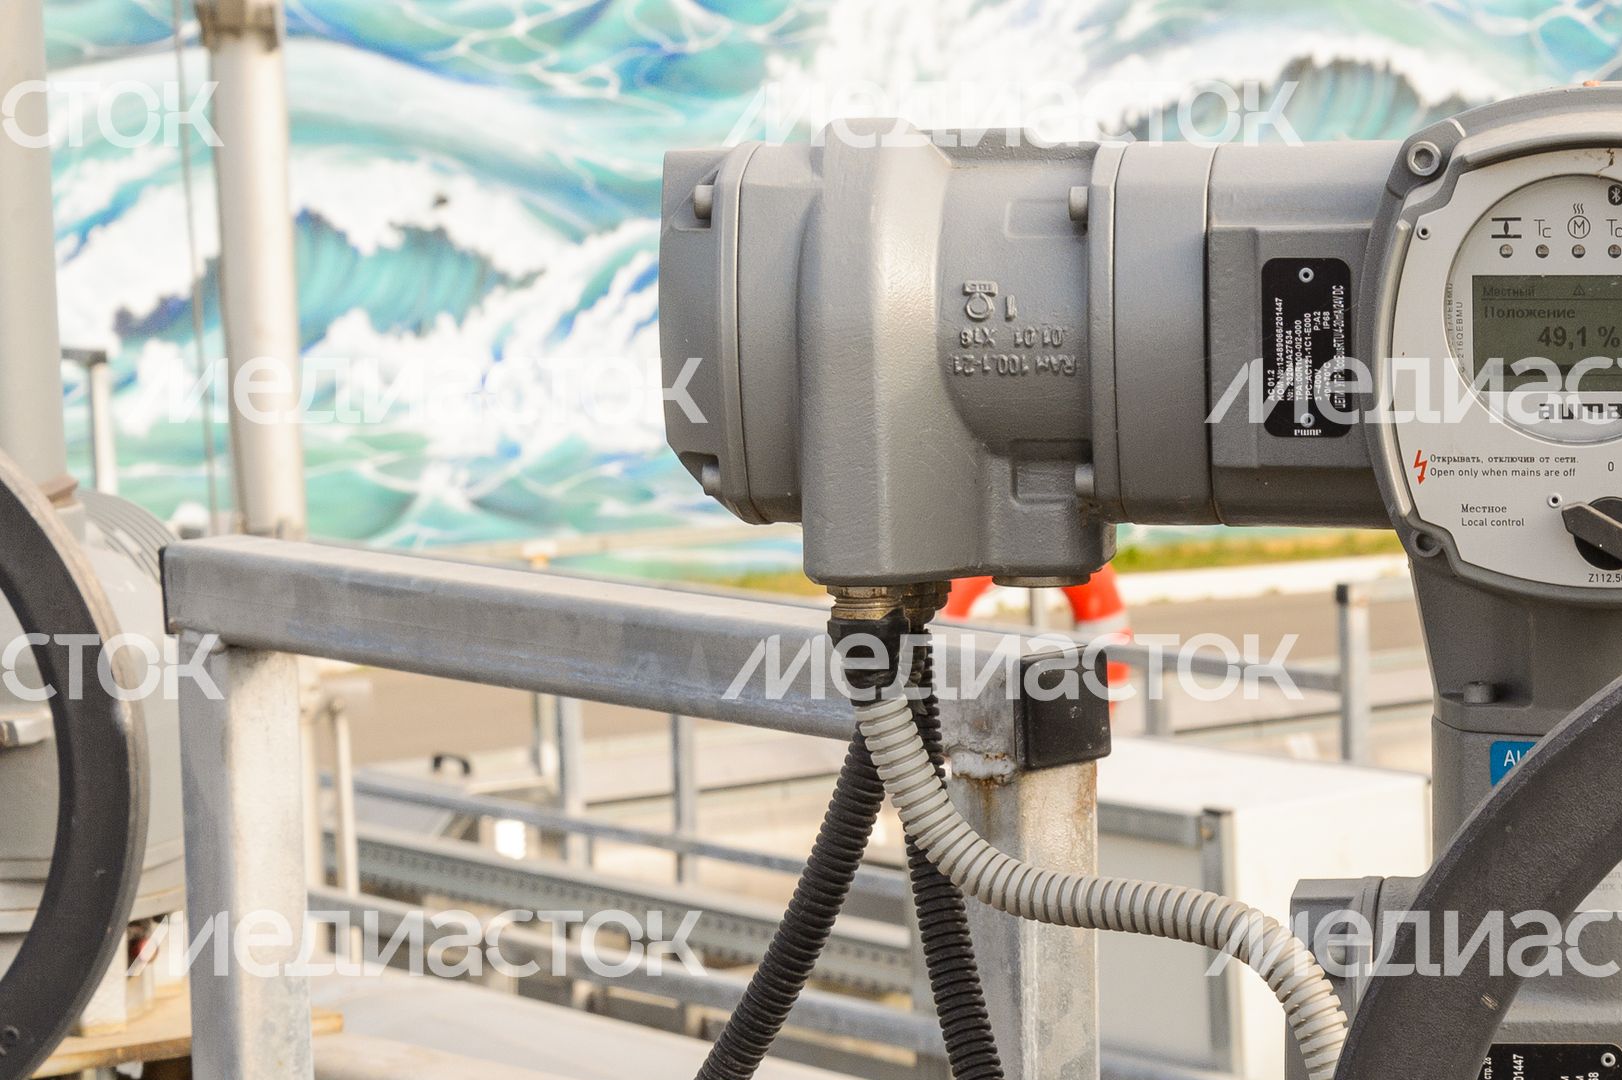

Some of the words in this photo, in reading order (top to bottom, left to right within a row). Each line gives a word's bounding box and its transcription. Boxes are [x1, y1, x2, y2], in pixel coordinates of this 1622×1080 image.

[1484, 305, 1575, 319] Положение
[1538, 326, 1586, 350] 49,1
[1598, 326, 1620, 348] %
[1539, 403, 1622, 419] auma
[1430, 454, 1483, 465] Открывать,
[1430, 468, 1454, 477] Open
[1459, 468, 1478, 477] only
[1482, 468, 1506, 477] when
[1511, 468, 1540, 477] mains
[1563, 468, 1575, 476] off
[1461, 504, 1507, 513] Местное
[1462, 518, 1487, 526] Local
[1491, 518, 1524, 526] control
